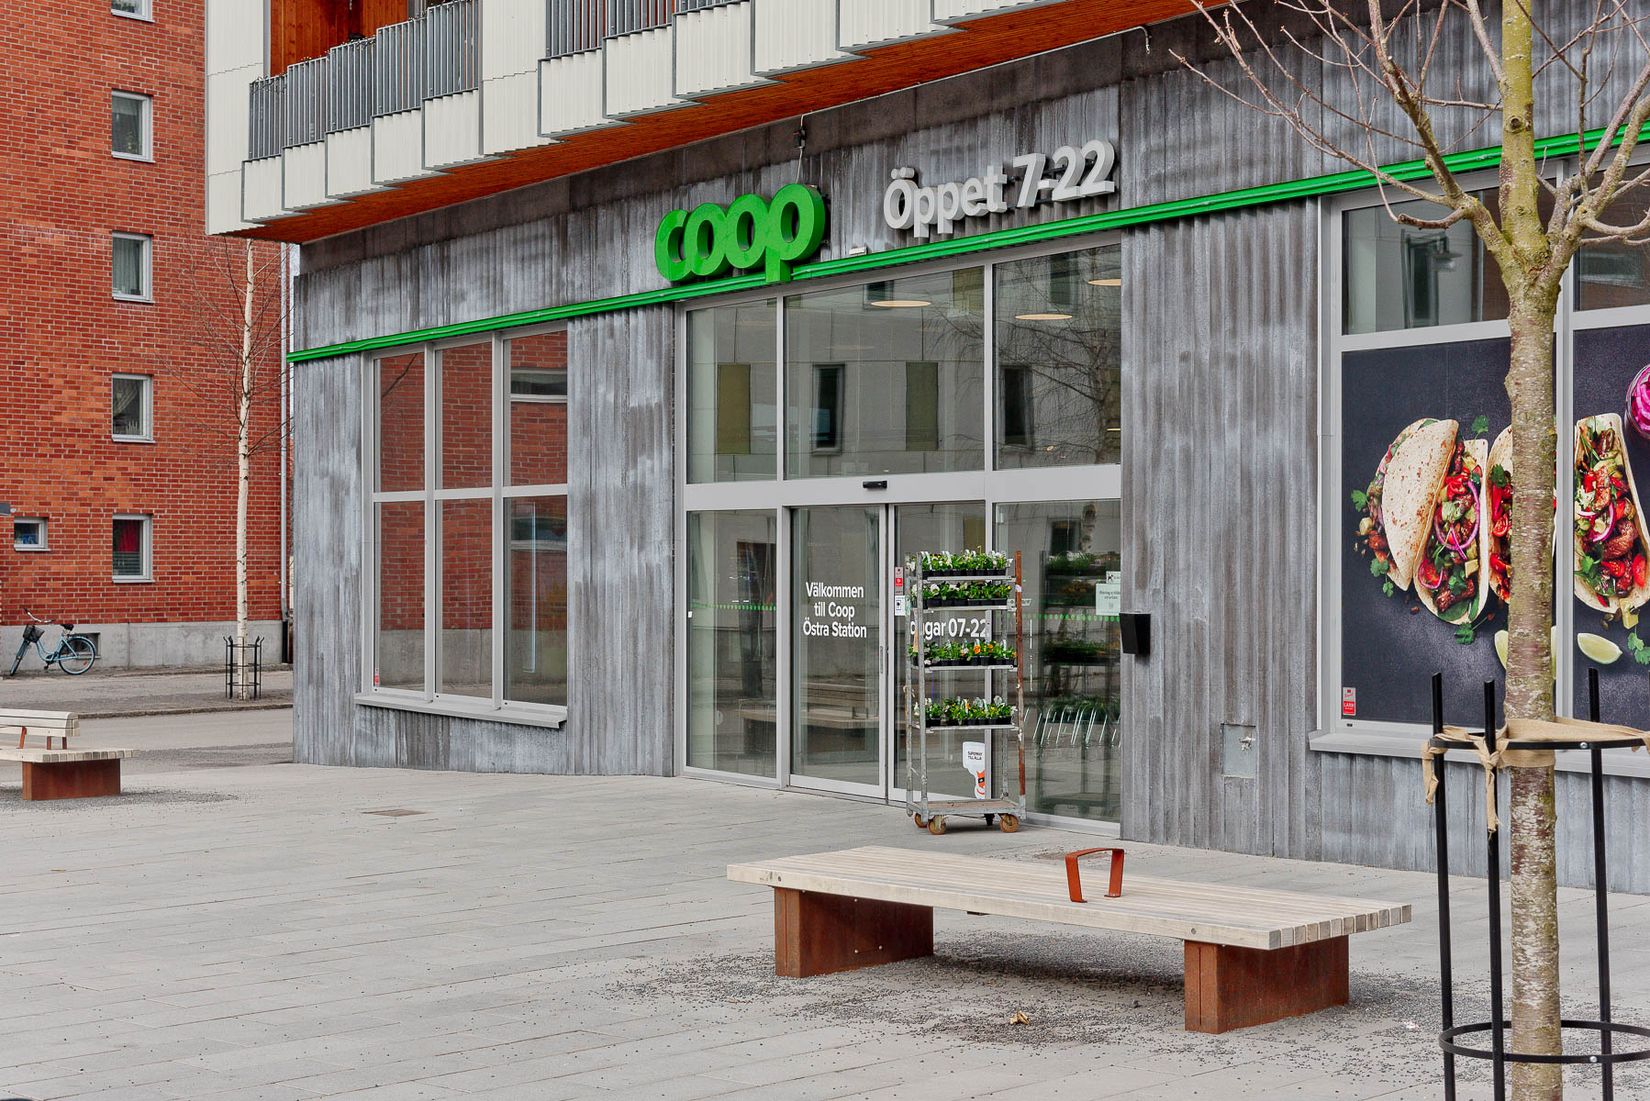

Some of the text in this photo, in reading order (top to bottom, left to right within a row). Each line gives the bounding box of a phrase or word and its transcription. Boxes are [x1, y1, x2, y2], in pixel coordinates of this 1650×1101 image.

[884, 140, 1115, 238] Öppet 7-22
[654, 183, 825, 282] coop
[805, 581, 864, 598] Välkommen
[814, 601, 855, 621] till Coop
[803, 616, 867, 638] Östra Station
[910, 620, 946, 640] gar
